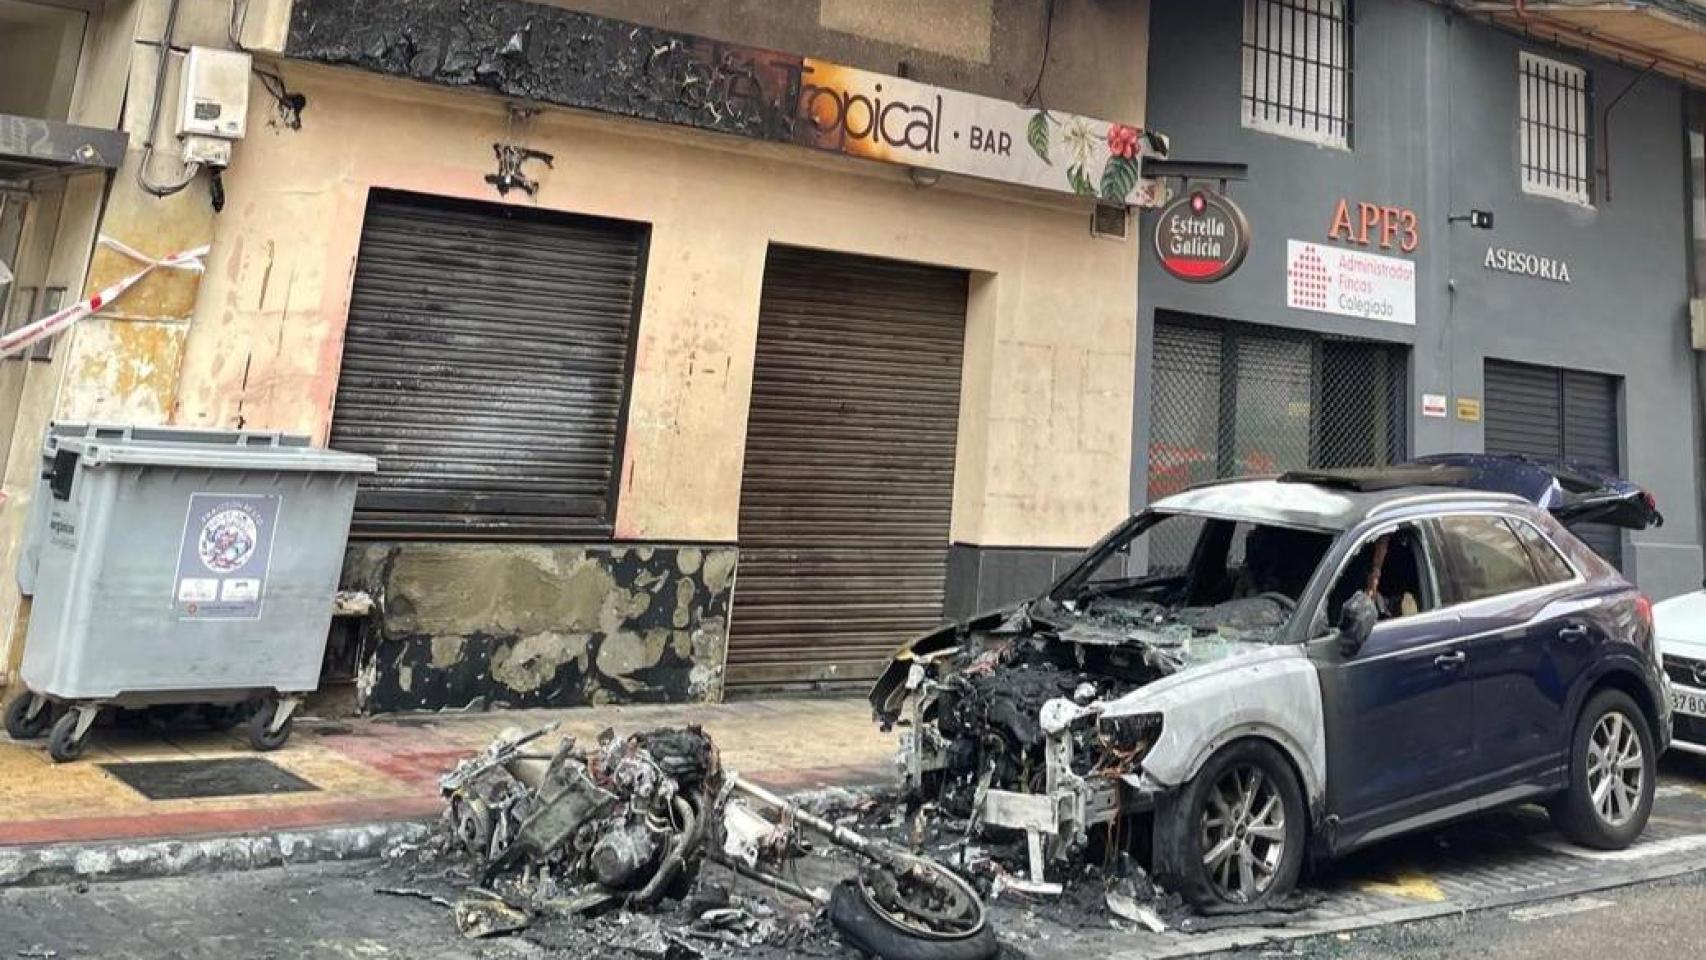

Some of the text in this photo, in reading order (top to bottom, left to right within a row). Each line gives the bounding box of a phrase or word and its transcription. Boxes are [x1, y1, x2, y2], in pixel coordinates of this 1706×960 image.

[968, 125, 1012, 157] BAR
[1169, 214, 1226, 238] Estrella
[1327, 198, 1419, 252] APF3
[1169, 233, 1222, 259] Galicia
[1338, 255, 1413, 281] Administrador
[1484, 246, 1571, 283] ASESORIA
[1338, 273, 1373, 294] Fincas
[1338, 292, 1393, 318] Colegiado
